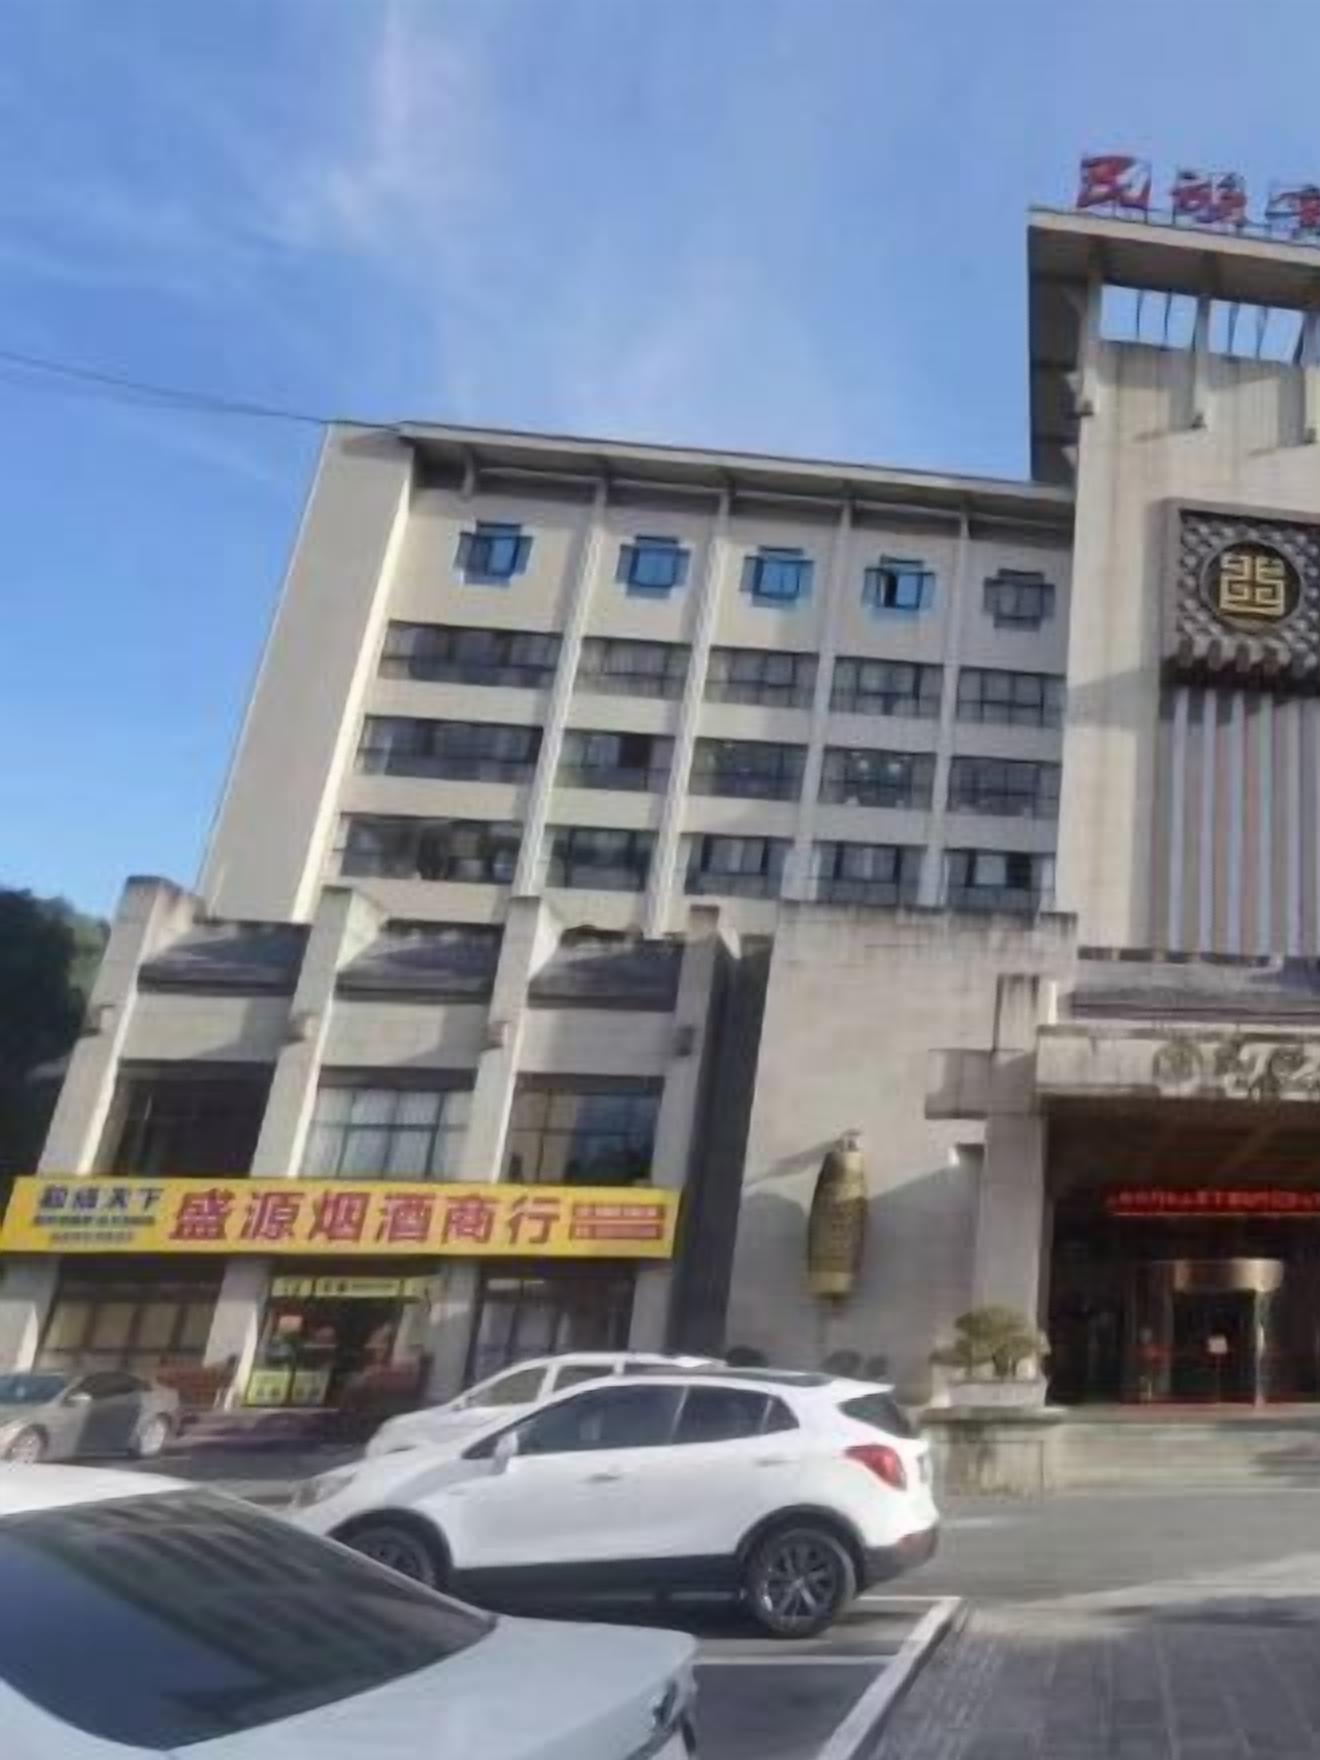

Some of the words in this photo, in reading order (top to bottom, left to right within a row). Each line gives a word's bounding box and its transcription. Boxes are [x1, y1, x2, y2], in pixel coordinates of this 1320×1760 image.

[169, 1188, 561, 1245] 盛源烟酒商行
